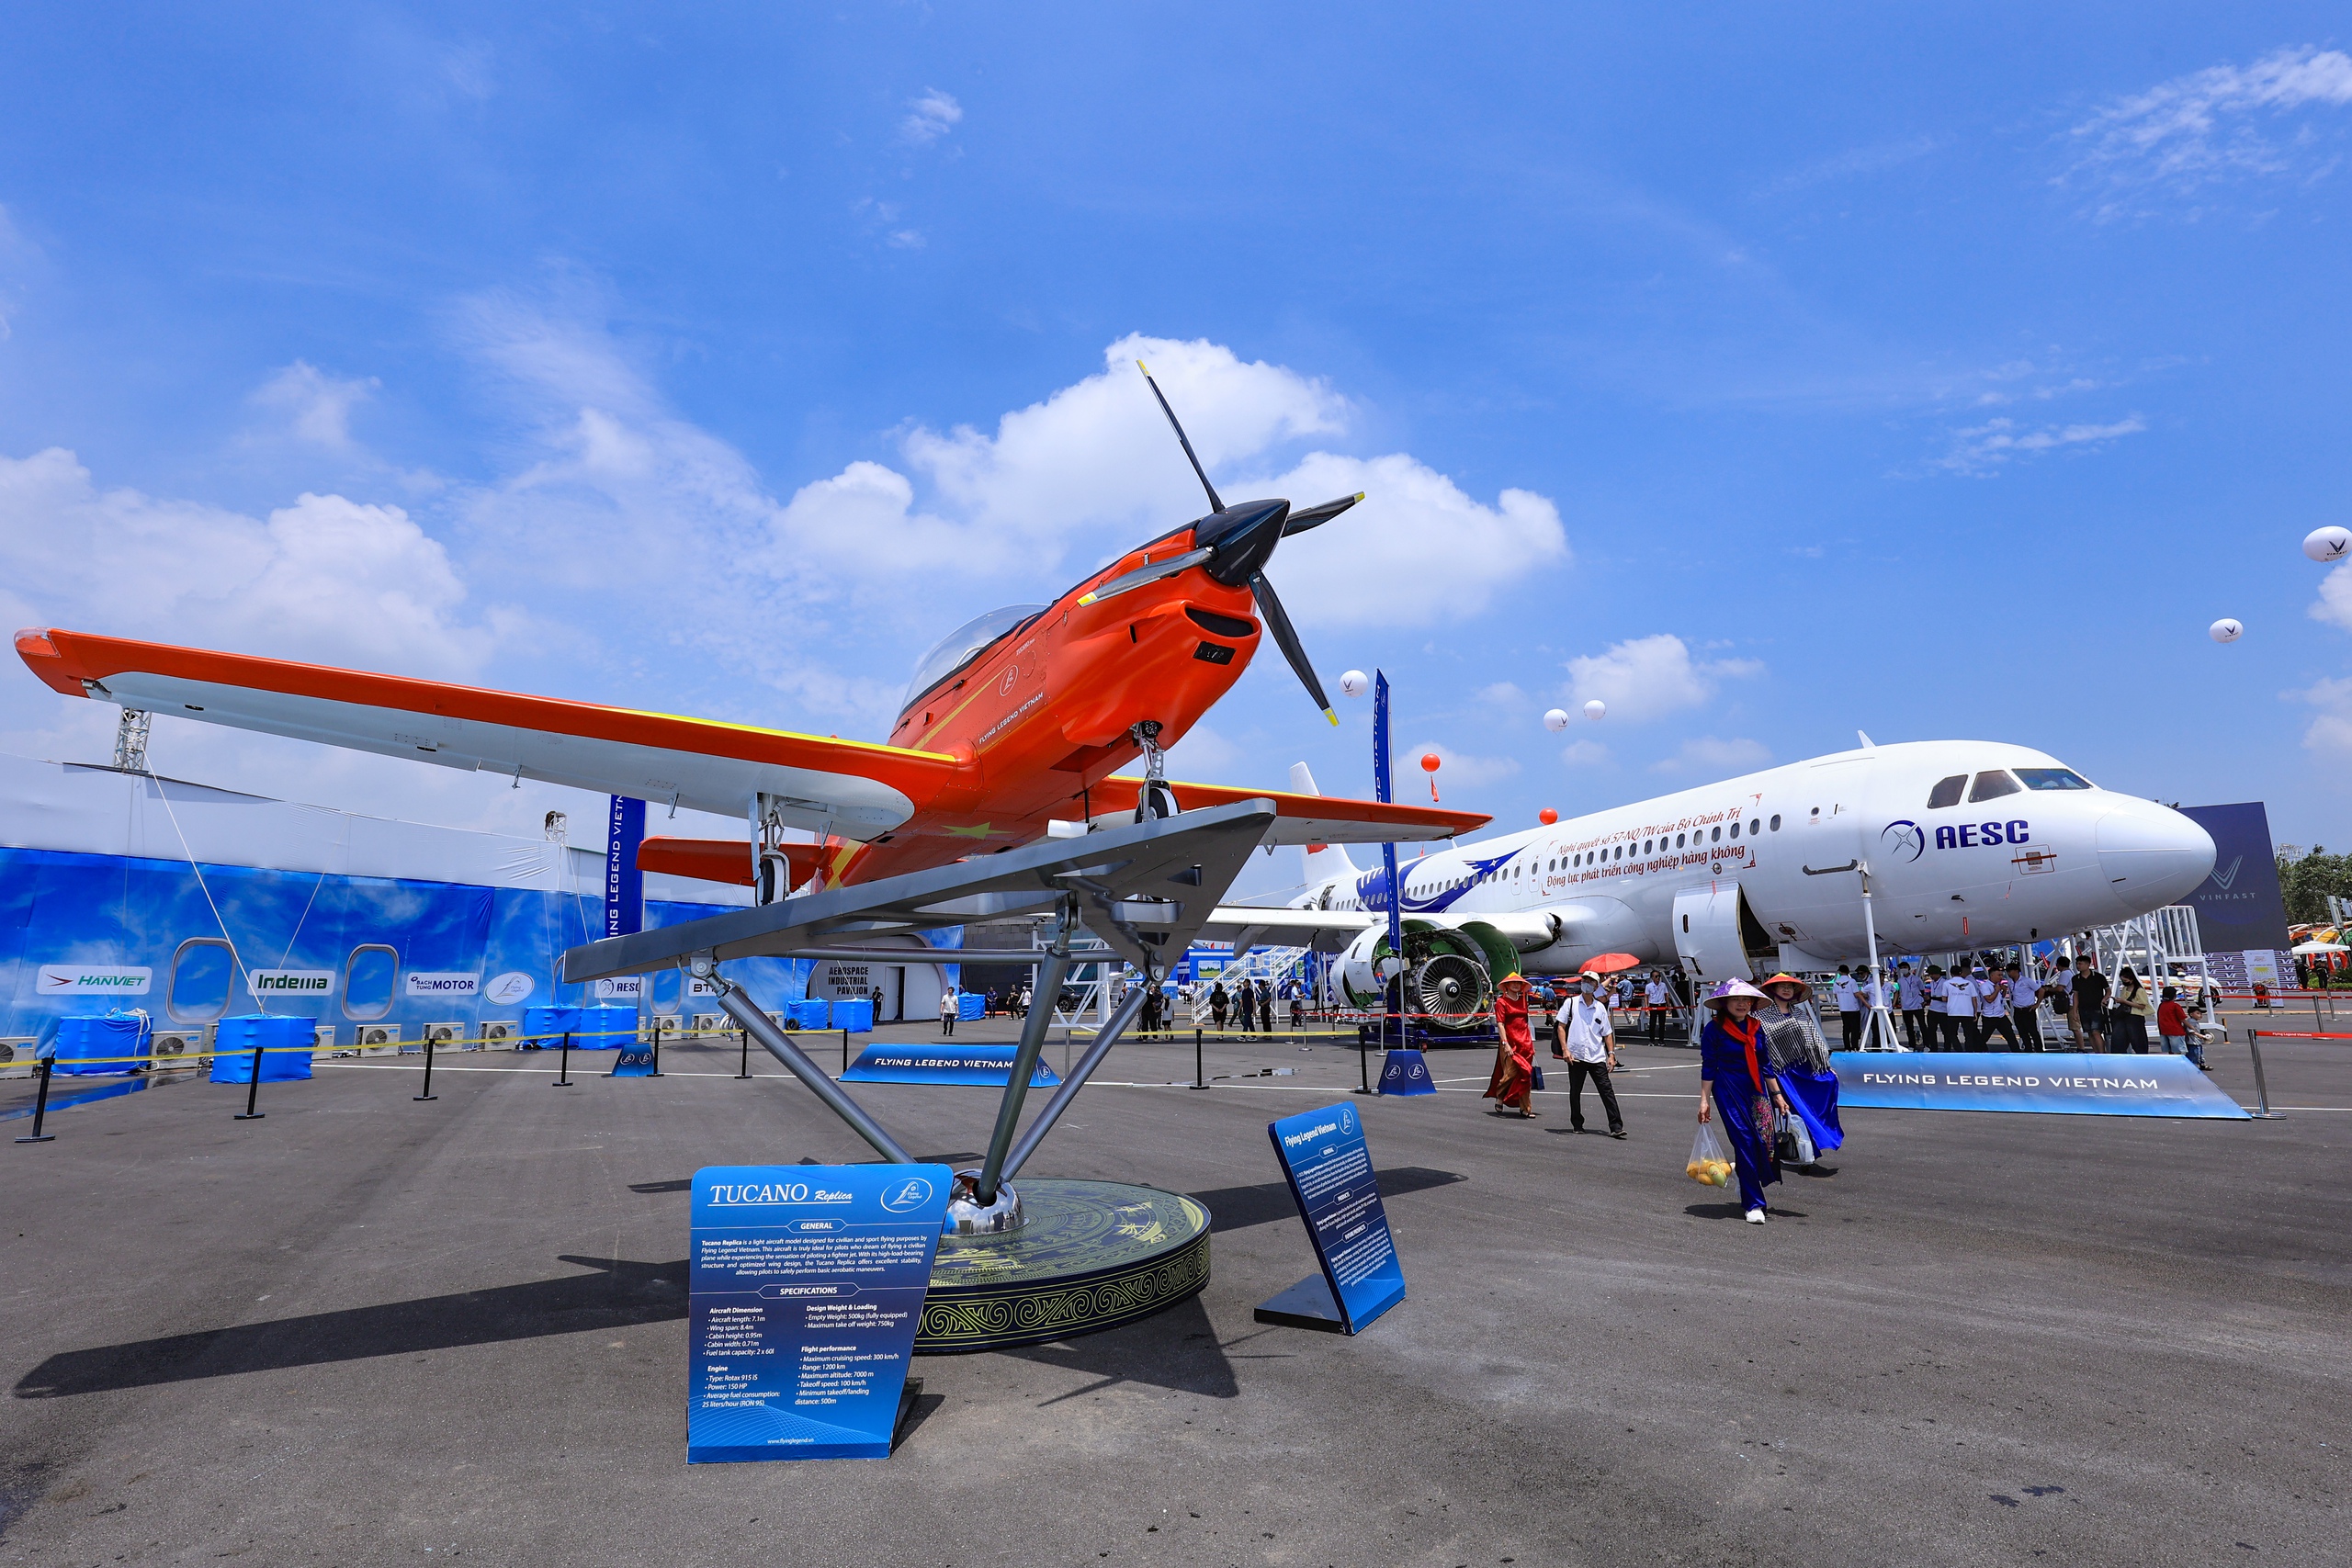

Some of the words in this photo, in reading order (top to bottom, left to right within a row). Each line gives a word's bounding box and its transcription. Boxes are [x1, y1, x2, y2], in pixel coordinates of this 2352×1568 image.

[979, 728, 996, 744] FLYING
[997, 712, 1018, 730] LEGEND
[1019, 692, 1043, 713] VIETNAM
[1557, 844, 1577, 856] Nghị
[1600, 833, 1613, 845] số
[1611, 825, 1659, 843] 57-NQ/TW
[1657, 822, 1675, 834] của
[1677, 818, 1691, 831] Bộ
[1693, 812, 1724, 827] Chính
[1727, 807, 1742, 821] Trị
[1935, 820, 2030, 849] AESC
[610, 841, 621, 902] LEGEND
[1547, 875, 1566, 888] Động
[1568, 873, 1579, 885] lực
[1582, 868, 1599, 883] phát
[1602, 863, 1621, 878] triển
[1624, 863, 1644, 875] công
[1647, 855, 1679, 872] nghiệp
[1682, 851, 1707, 865] hàng
[1711, 845, 1745, 860] không
[2200, 892, 2256, 901] VINFAST
[432, 980, 474, 989] MOTOR
[874, 1058, 911, 1066] FLYING
[915, 1059, 959, 1067] LEGEND
[963, 1060, 1013, 1068] VIETNAM
[1862, 1073, 1940, 1086] FLYING
[1947, 1075, 2040, 1087] LEGEND
[2048, 1077, 2159, 1090] VIETNAM
[1285, 1135, 1302, 1147] Flying
[1300, 1127, 1319, 1142] Legend
[1317, 1123, 1337, 1135] Vietnam
[710, 1184, 808, 1203] TUCANO
[814, 1190, 853, 1201] Replica
[819, 1345, 856, 1353] performance
[742, 1391, 780, 1399] consumption:
